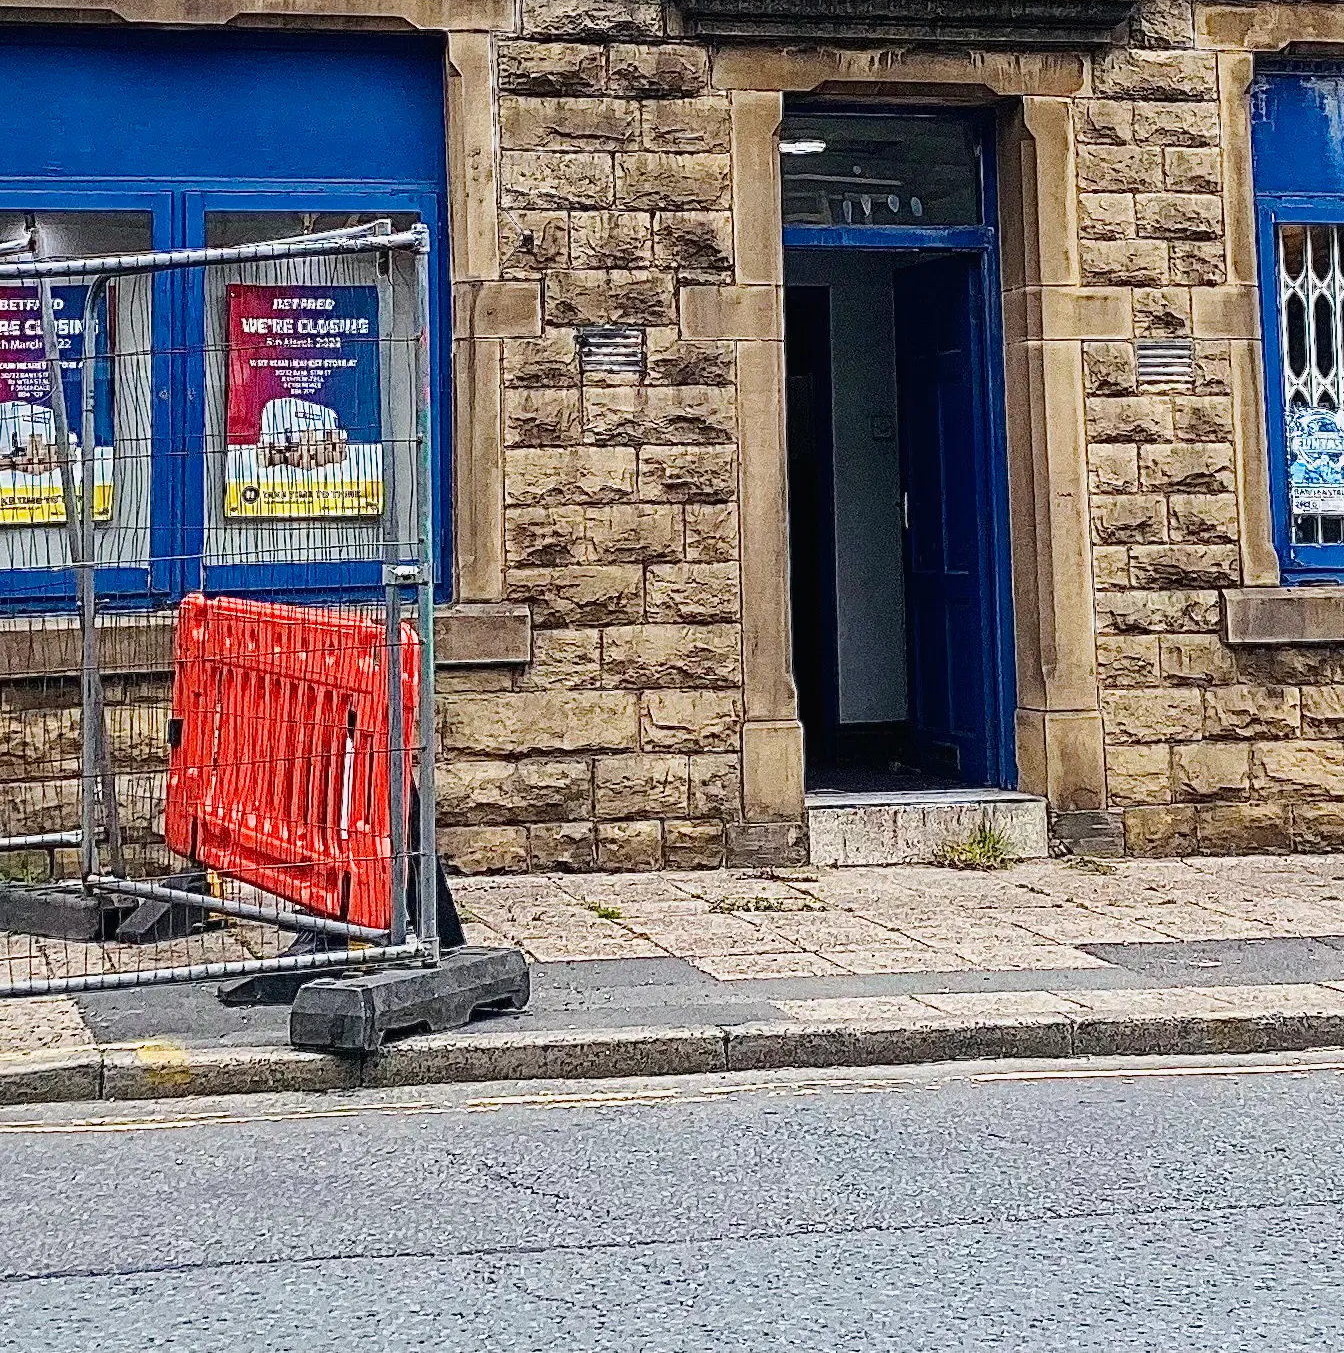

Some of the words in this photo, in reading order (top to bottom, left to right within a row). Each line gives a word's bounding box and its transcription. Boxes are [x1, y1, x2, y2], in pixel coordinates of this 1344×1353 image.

[272, 298, 335, 310] BETFRED
[24, 319, 99, 335] CLSIN
[241, 318, 294, 334] WE'RE
[297, 318, 369, 334] CLOSING
